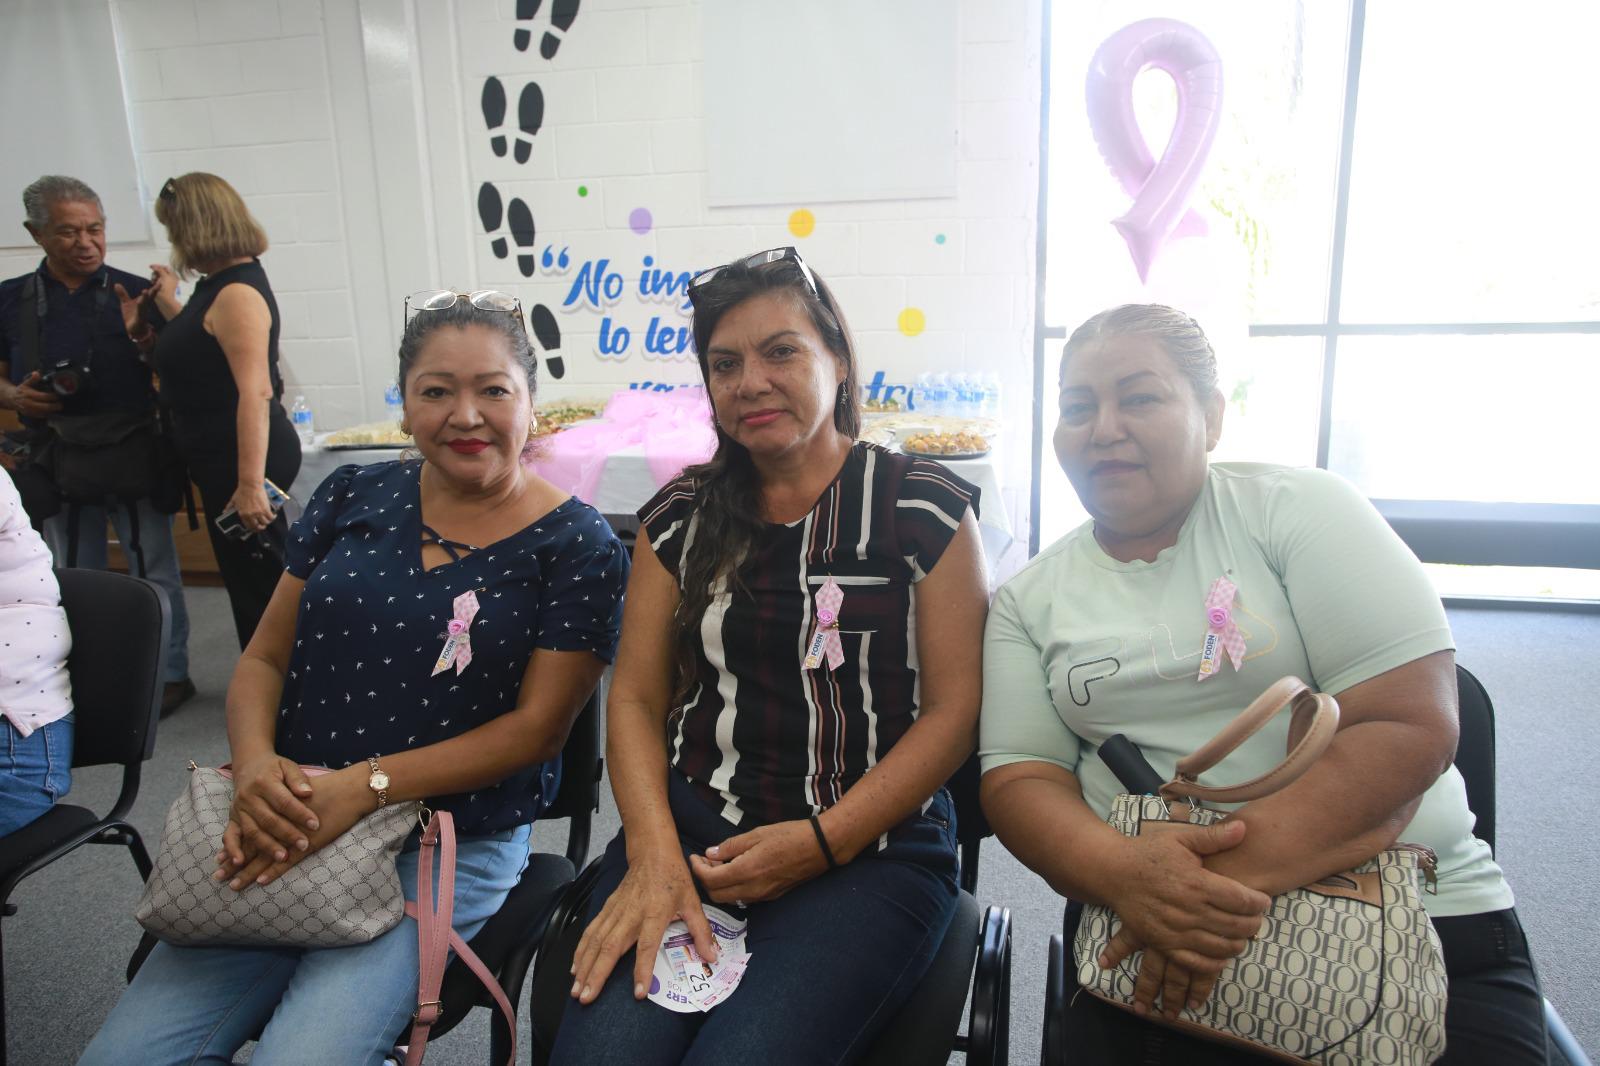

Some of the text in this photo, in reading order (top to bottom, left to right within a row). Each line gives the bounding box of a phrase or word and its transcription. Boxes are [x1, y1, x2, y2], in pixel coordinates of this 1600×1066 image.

[639, 255, 702, 310] im
[599, 317, 631, 355] lo
[811, 634, 824, 656] FODEN
[1204, 634, 1215, 660] FODEN
[690, 973, 710, 993] 52
[666, 990, 688, 1004] ER?
